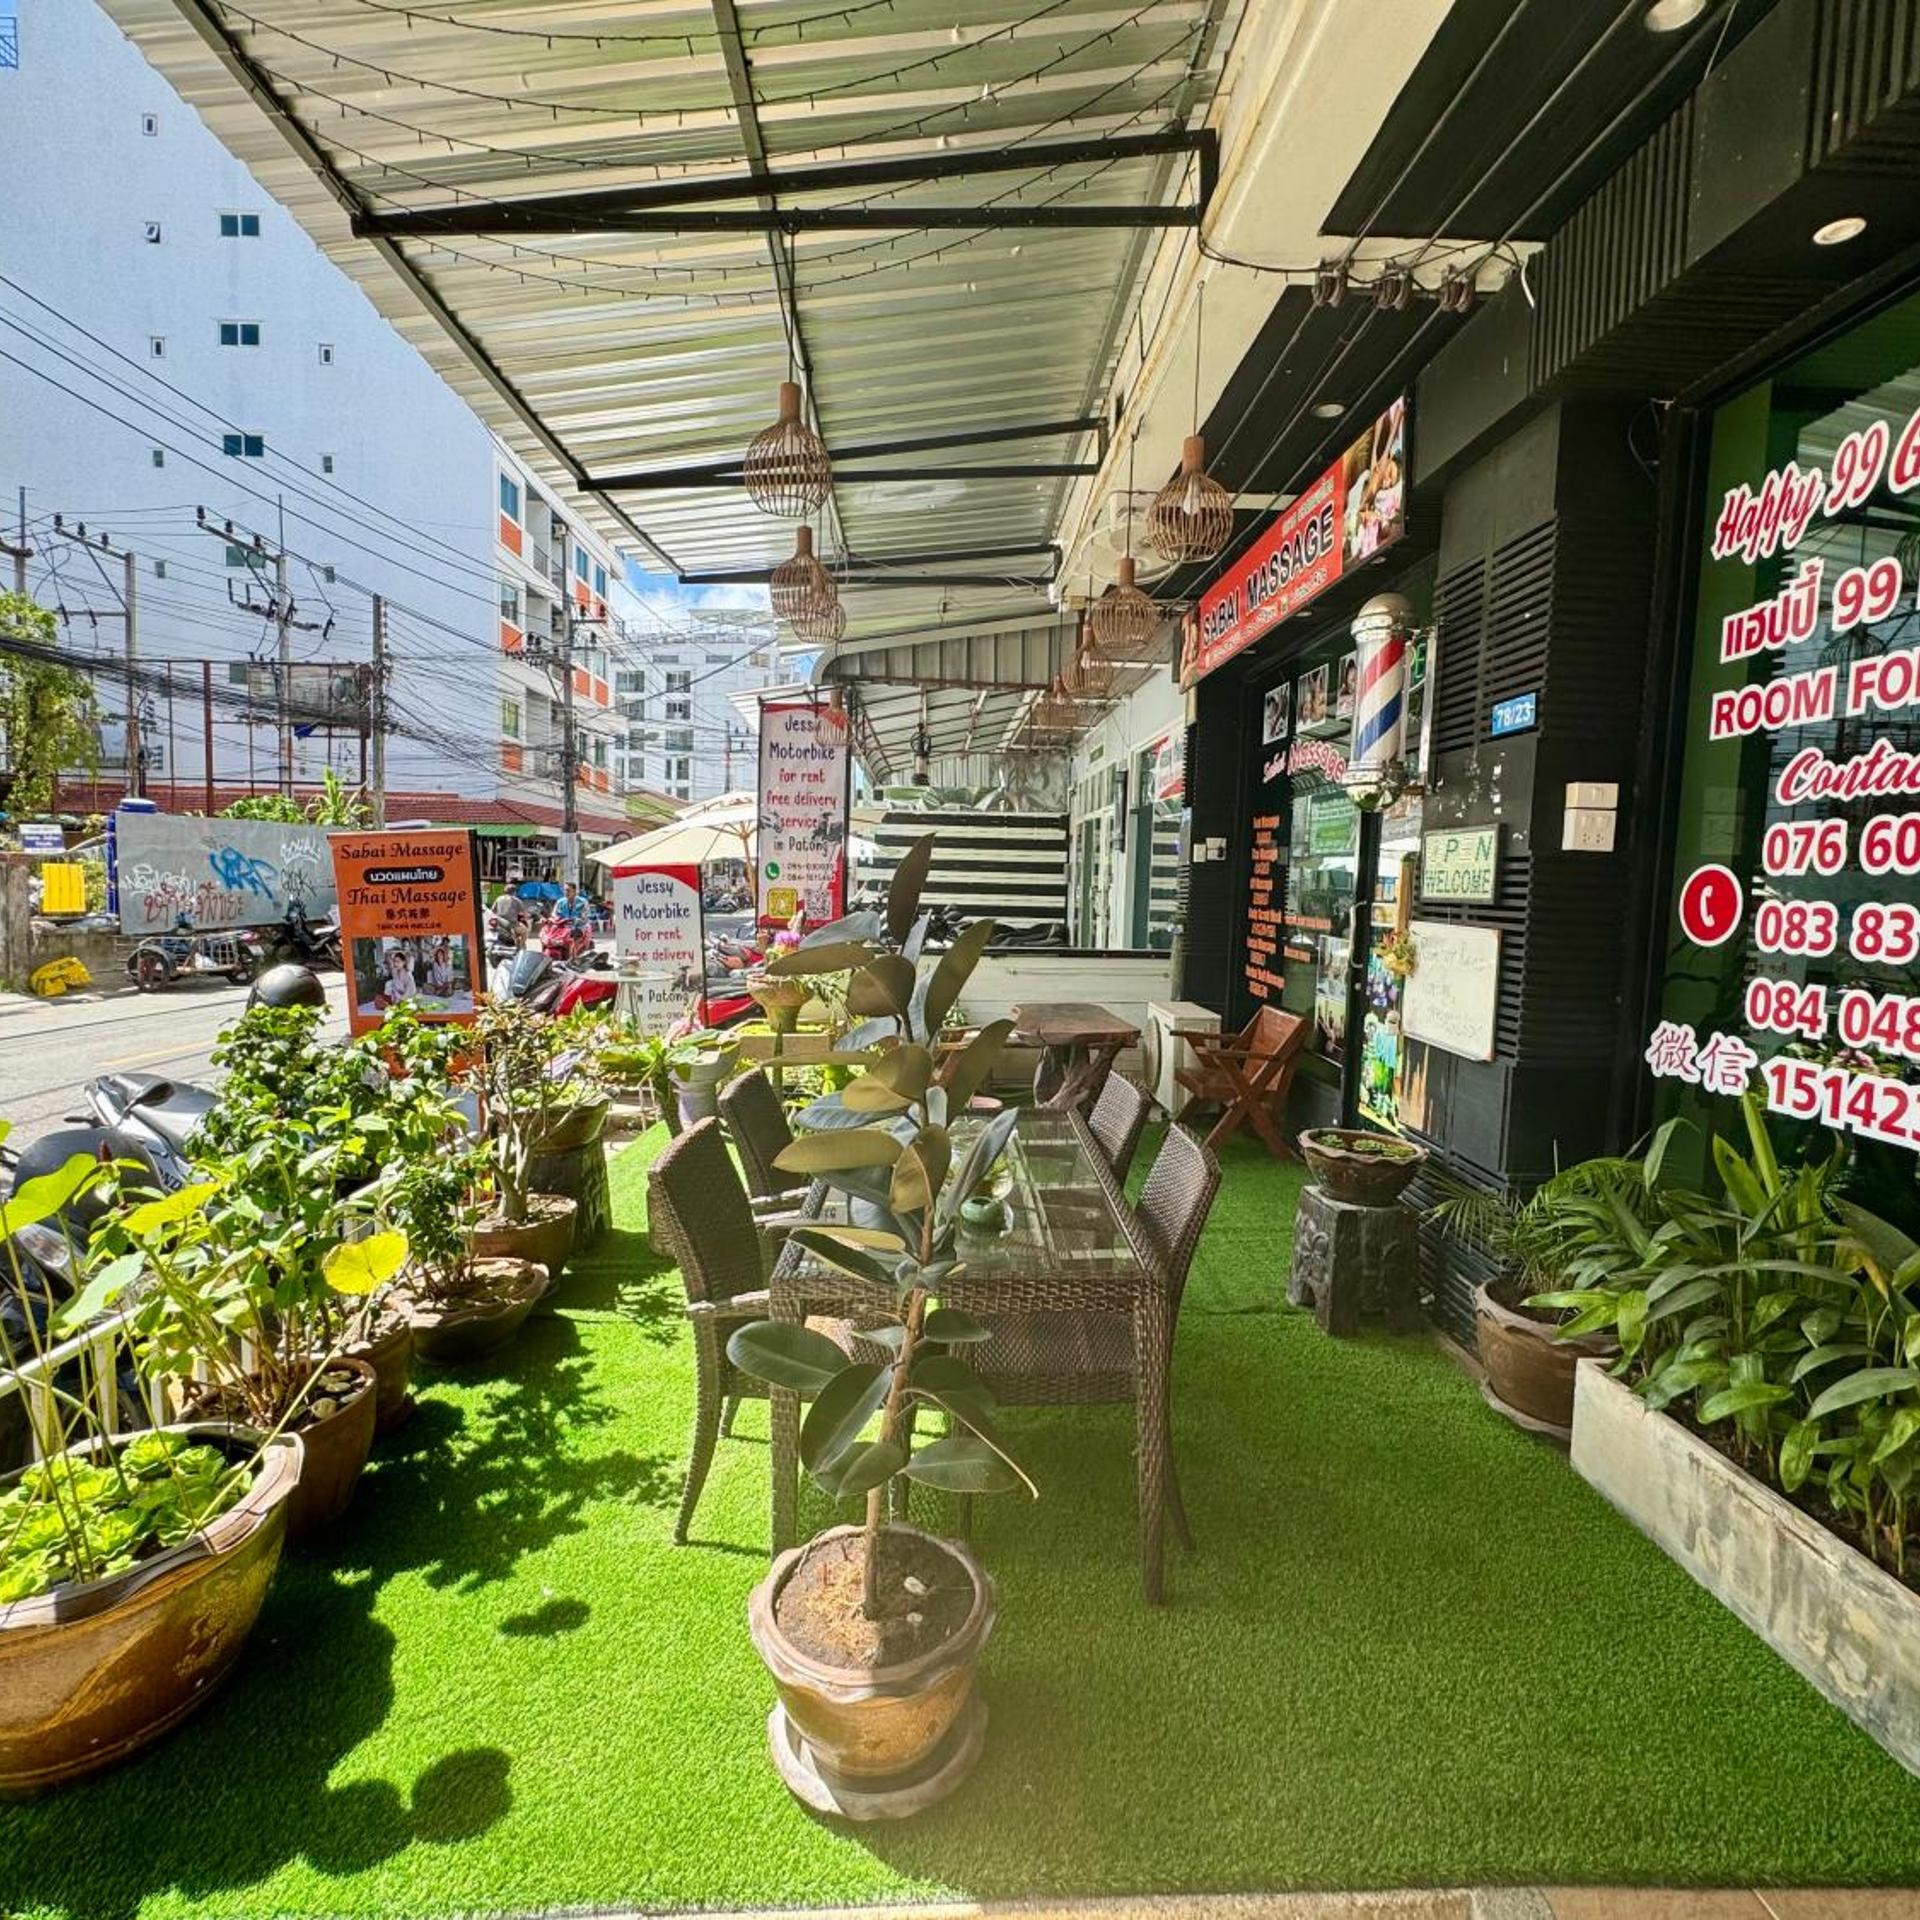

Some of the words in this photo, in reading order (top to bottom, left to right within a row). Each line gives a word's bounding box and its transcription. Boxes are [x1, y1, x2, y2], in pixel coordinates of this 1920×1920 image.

[1714, 463, 1823, 561] Happy
[1827, 424, 1886, 514] 99
[1203, 587, 1240, 648] SABAI
[1246, 501, 1334, 615] MASSAGE
[1835, 560, 1899, 628] 99
[1712, 669, 1835, 737] ROOM
[1849, 649, 1920, 713] FO
[1496, 703, 1530, 726] 78/23
[769, 741, 835, 760] Motorbike
[780, 767, 796, 783] for
[801, 768, 826, 783] rent
[766, 789, 789, 805] free
[794, 788, 837, 809] delivery
[780, 817, 817, 828] service
[340, 842, 386, 860] Sabai
[389, 842, 464, 862] Massage
[789, 836, 828, 857] Patong
[1765, 821, 1844, 872] 076
[370, 868, 438, 882] นวดแผนไทย
[347, 888, 386, 905] Thai
[391, 887, 467, 909] Massage
[637, 878, 674, 897] Jessy
[623, 903, 691, 920] Motorbike
[658, 928, 682, 941] rent
[1758, 903, 1836, 954] 083
[1853, 905, 1918, 961] 83
[653, 948, 695, 964] delivery
[1747, 980, 1825, 1036] 084
[1648, 1023, 1753, 1093] 微信
[1765, 1060, 1920, 1146] 15142
